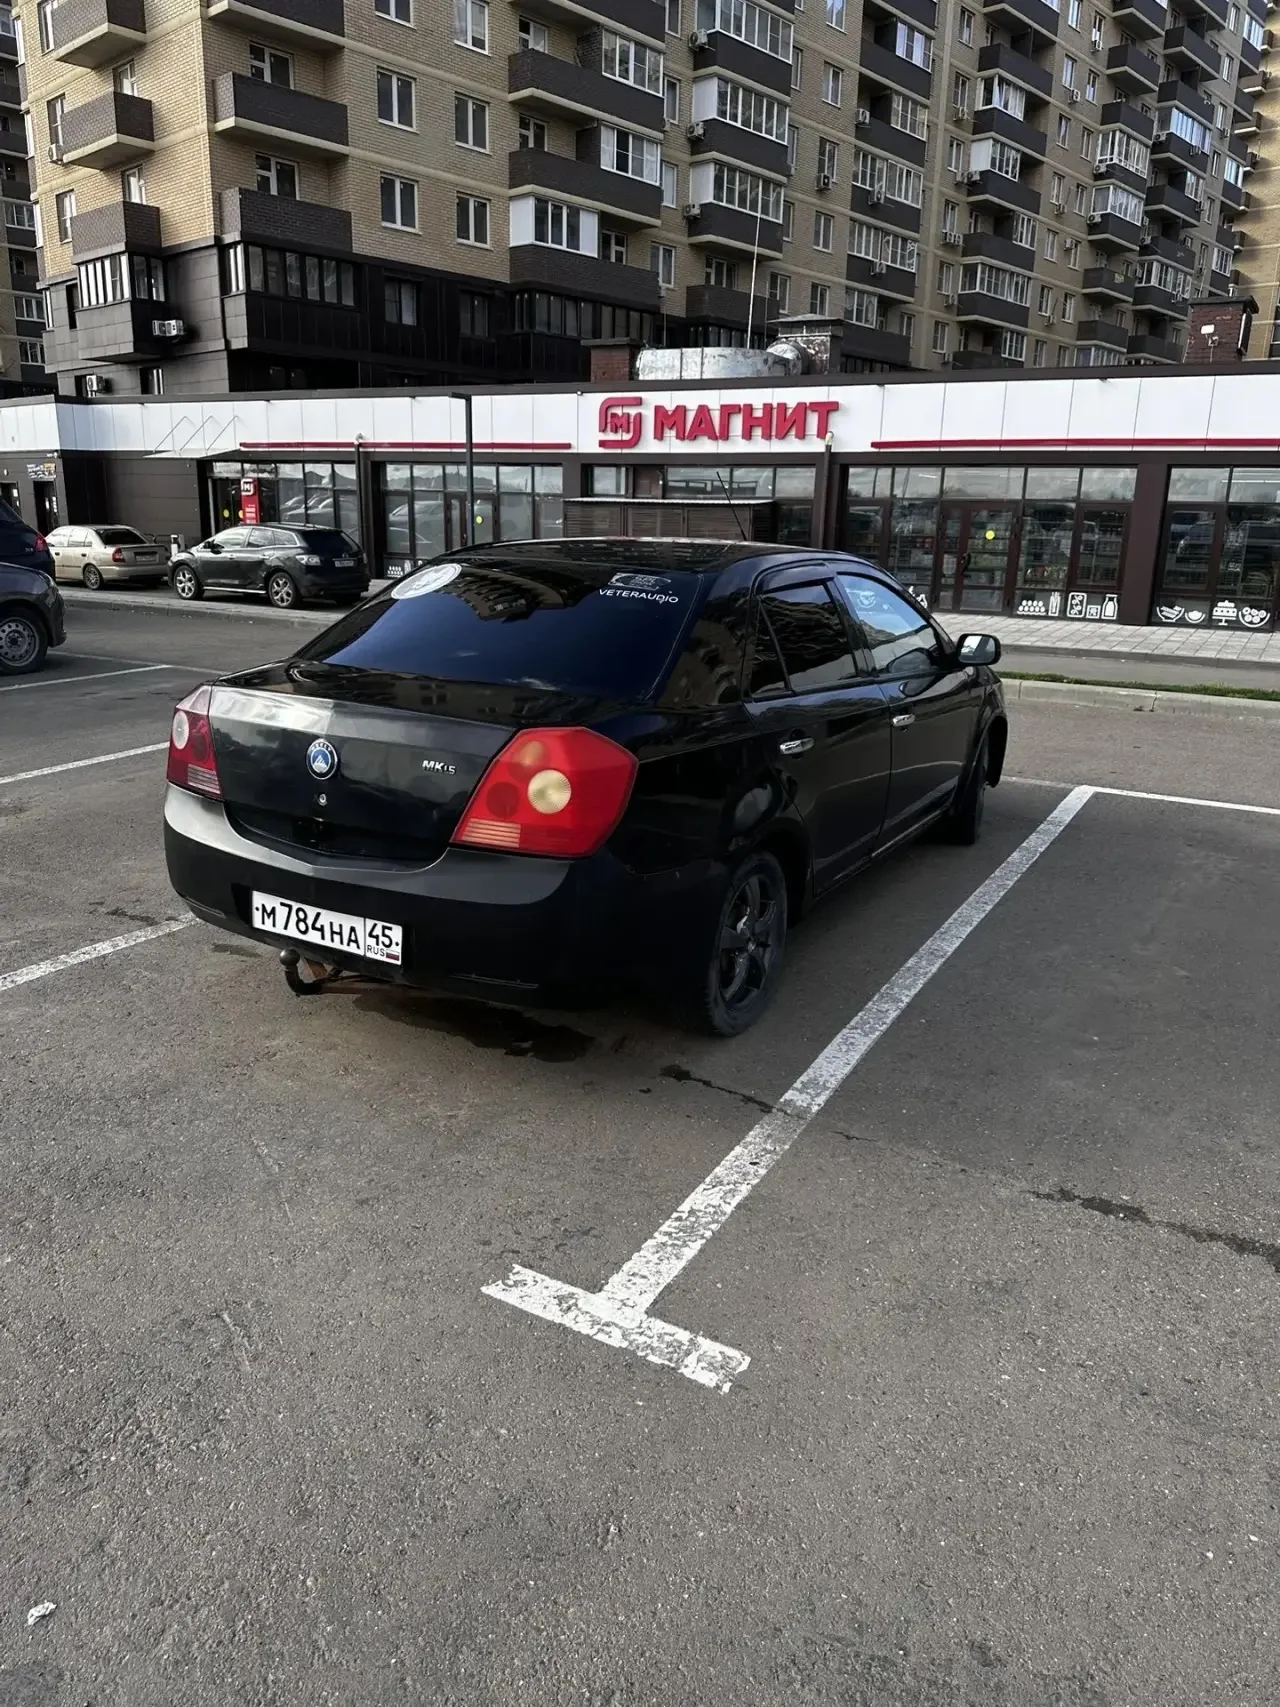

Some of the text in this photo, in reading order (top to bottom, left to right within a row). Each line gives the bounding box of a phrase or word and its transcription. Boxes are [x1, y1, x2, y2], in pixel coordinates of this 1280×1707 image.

[653, 401, 839, 441] МАГНИТ
[599, 588, 679, 603] VETERAUDIO
[261, 902, 393, 950] М784НА 45
[366, 944, 385, 957] RUS
